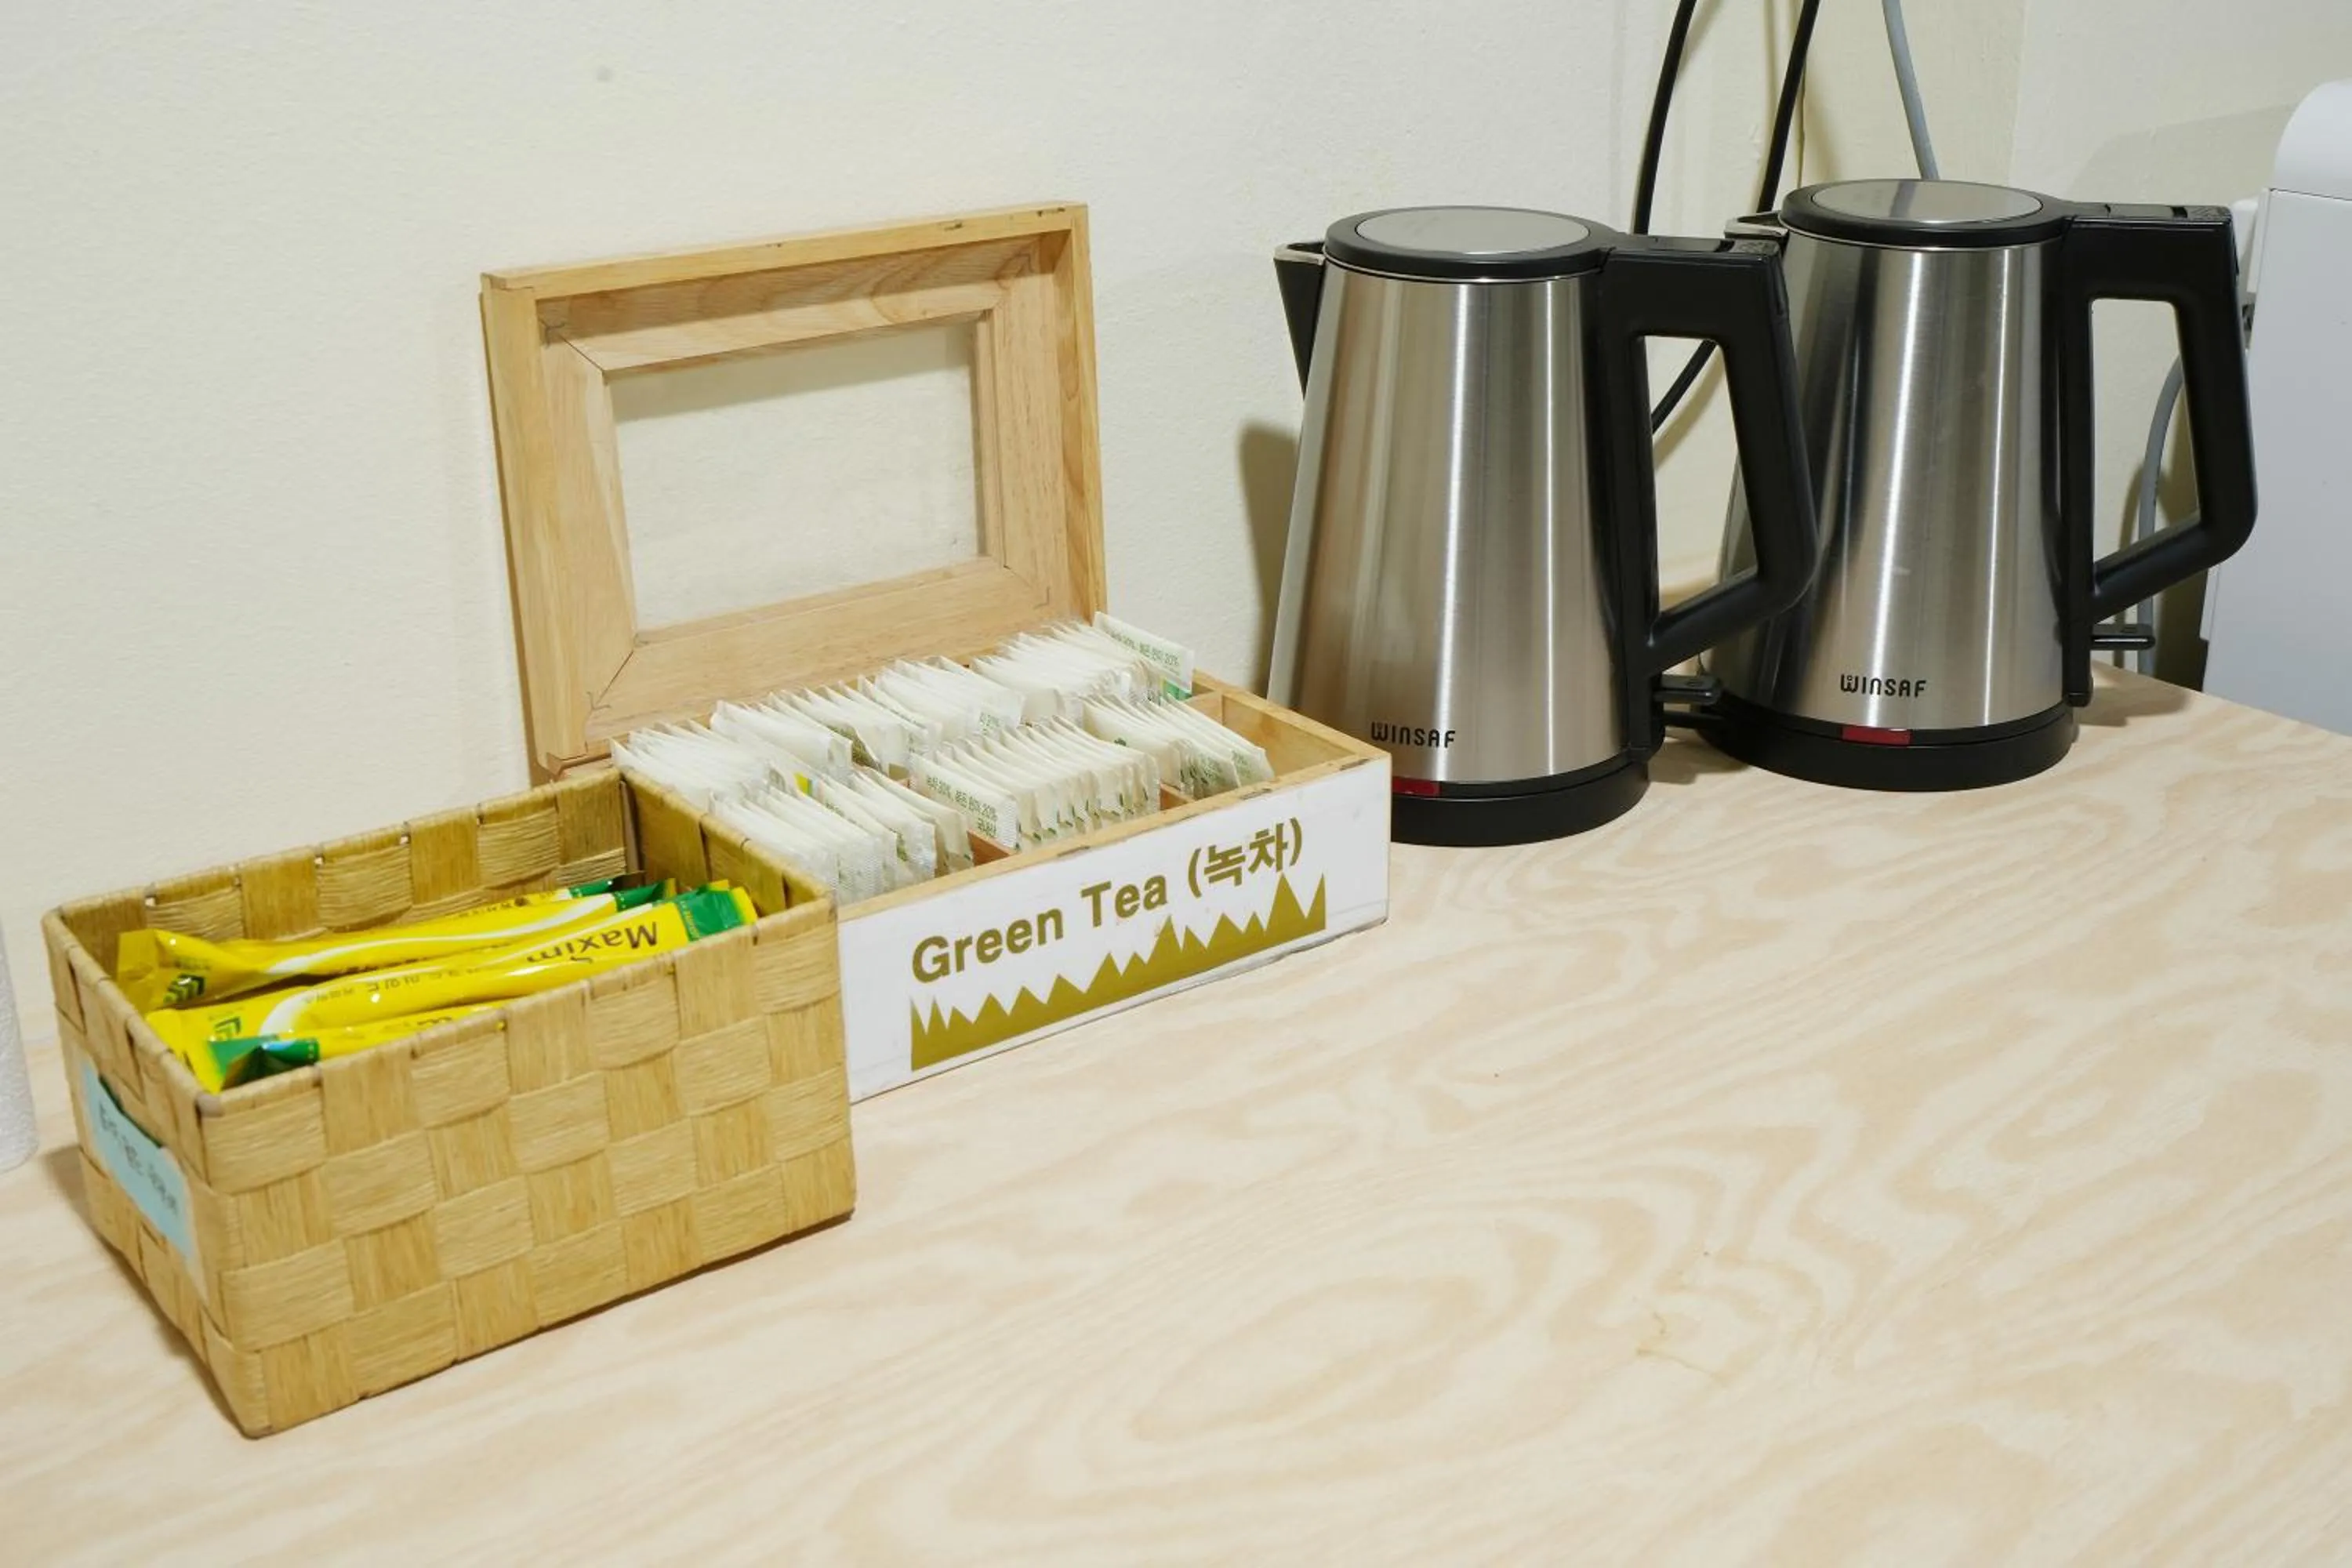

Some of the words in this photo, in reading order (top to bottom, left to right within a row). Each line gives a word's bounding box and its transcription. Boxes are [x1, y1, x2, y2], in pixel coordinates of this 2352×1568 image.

[1840, 673, 1927, 698] WINSAF
[1370, 721, 1456, 749] WINSAF
[912, 907, 1065, 983] Green
[1080, 873, 1168, 928] Tea
[1188, 817, 1303, 898] (녹차)
[526, 921, 658, 964] Maxim
